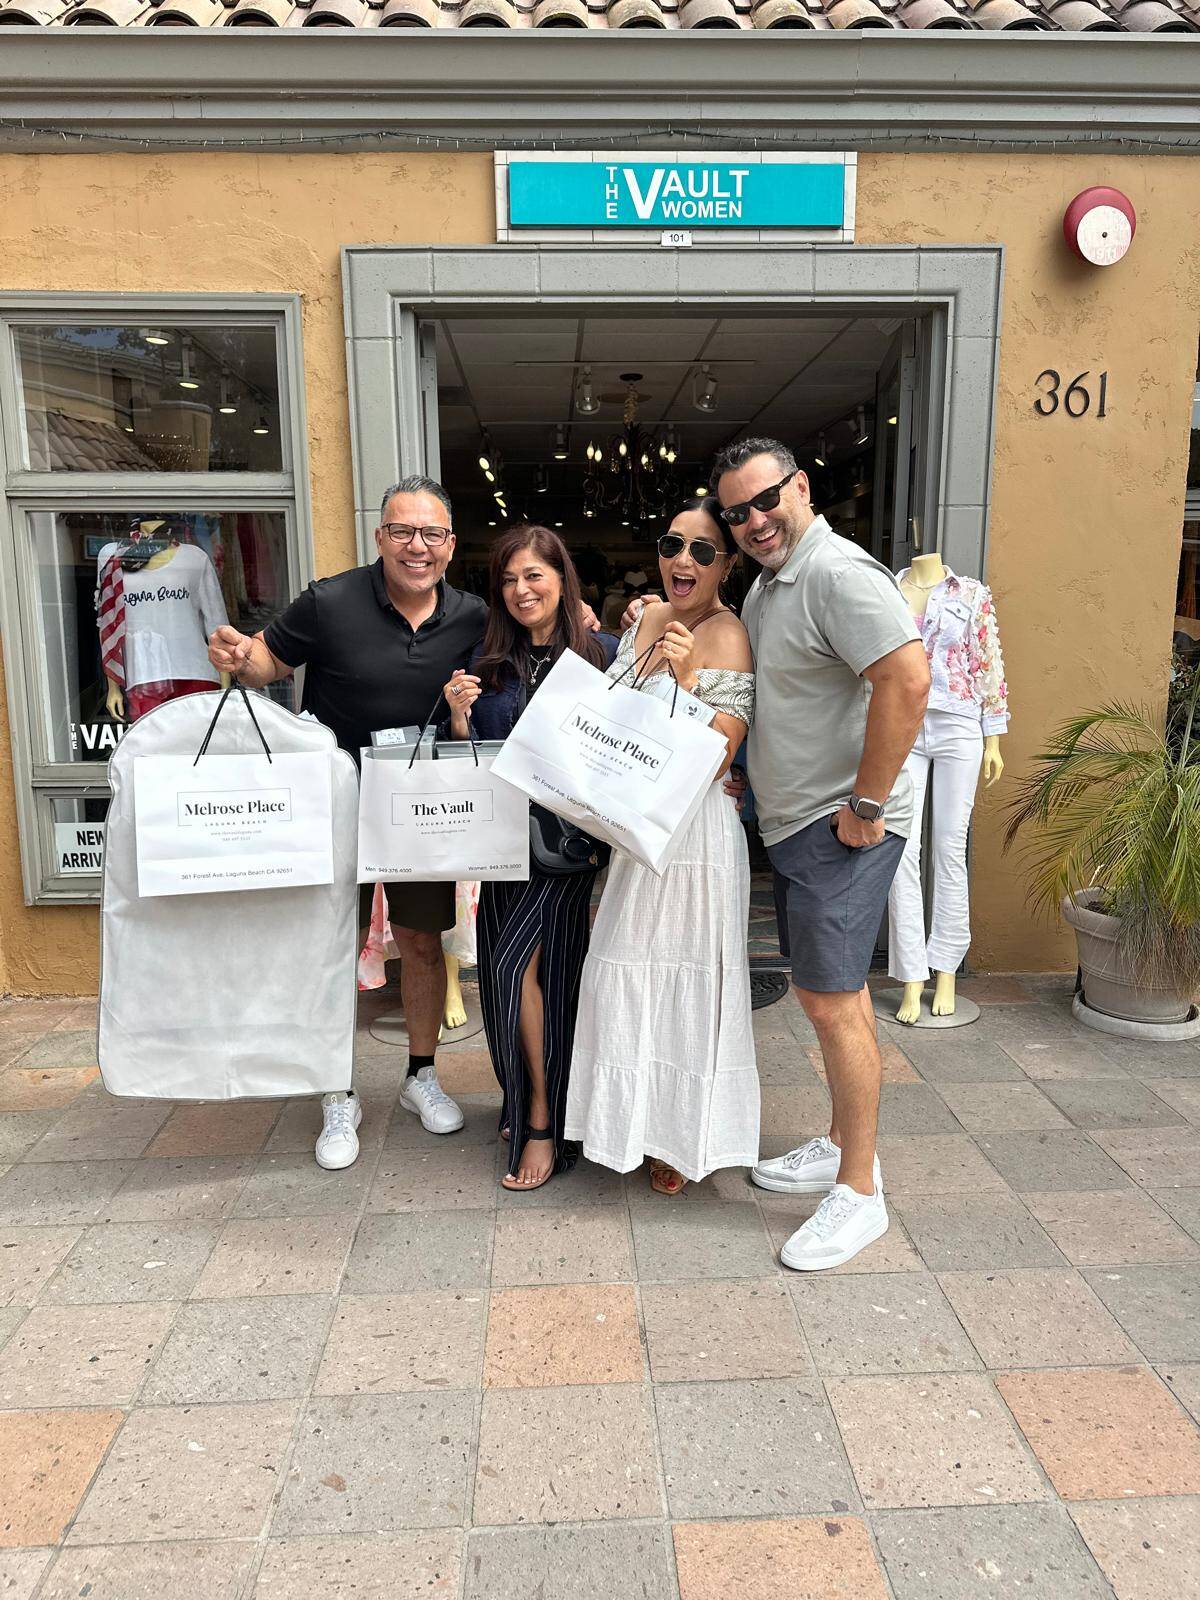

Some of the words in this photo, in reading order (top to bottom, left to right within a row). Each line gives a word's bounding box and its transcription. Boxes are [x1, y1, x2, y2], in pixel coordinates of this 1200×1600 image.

[605, 166, 619, 219] THE
[622, 168, 750, 219] VAULT
[661, 200, 742, 218] WOMEN
[668, 233, 685, 243] 101
[1034, 369, 1108, 418] 361
[123, 590, 156, 606] aguna
[157, 586, 190, 602] Beach
[70, 723, 78, 750] THE
[571, 715, 622, 749] Melrose
[622, 740, 659, 769] Place
[184, 802, 244, 816] Melrose
[248, 800, 286, 814] Place
[411, 803, 438, 816] The
[440, 800, 474, 814] Vault
[601, 815, 610, 824] CA
[62, 853, 102, 868] ARRIV
[226, 871, 247, 879] Laguna
